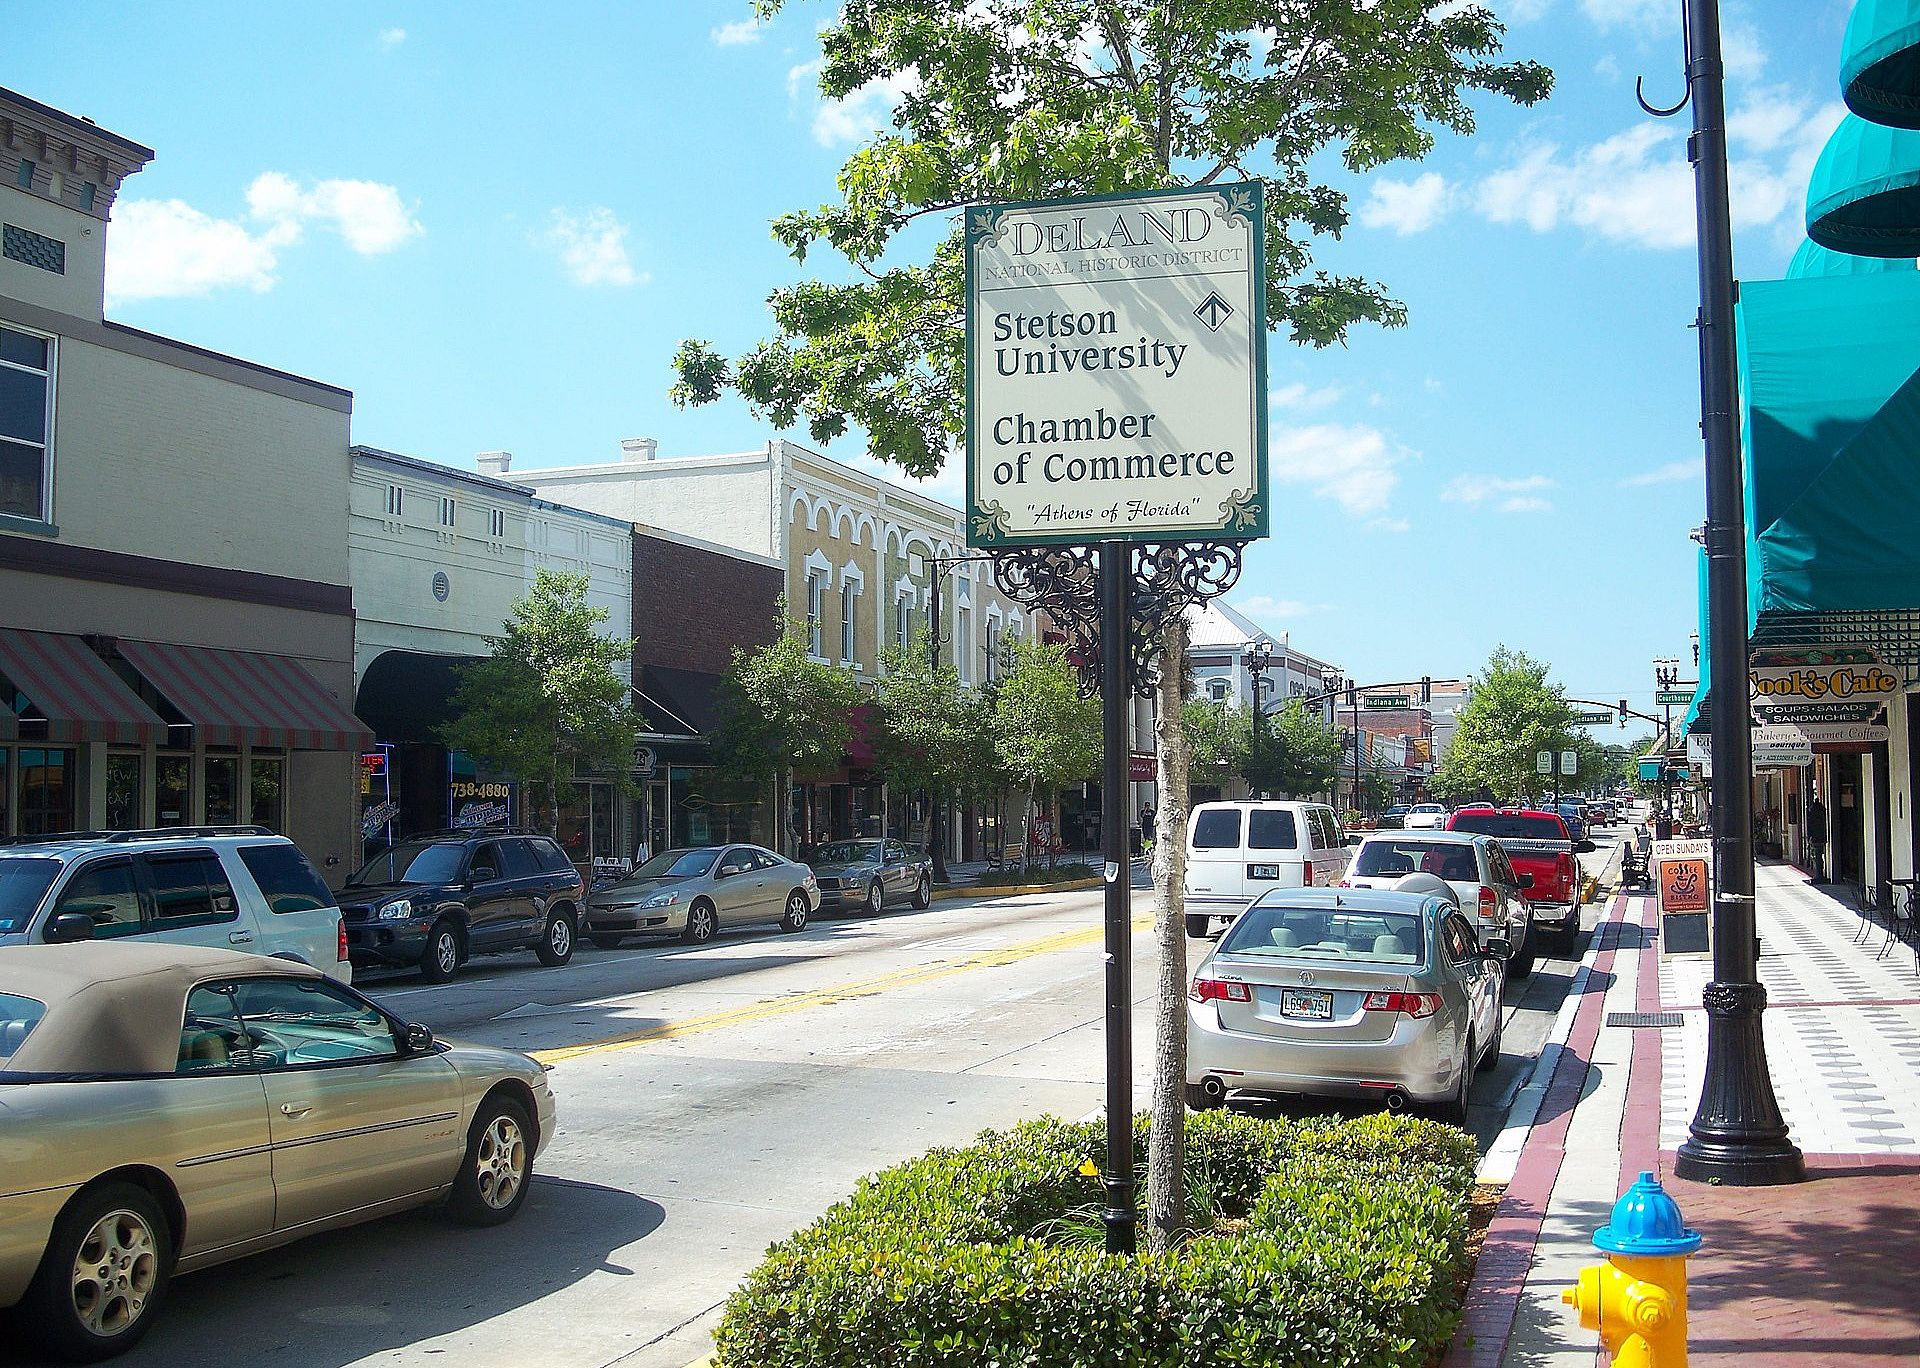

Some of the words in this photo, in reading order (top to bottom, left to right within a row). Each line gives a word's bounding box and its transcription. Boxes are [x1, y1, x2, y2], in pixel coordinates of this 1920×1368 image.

[1012, 207, 1212, 256] DELAND
[985, 262, 1074, 280] NATIONAL
[1079, 253, 1158, 273] HISTORIC
[1162, 247, 1243, 267] DISTRICT
[994, 308, 1118, 342] Stetson
[994, 336, 1188, 379] University
[993, 408, 1155, 445] Chamber
[993, 451, 1032, 485] of
[1043, 449, 1235, 483] Commerce
[1027, 503, 1093, 525] "Athens
[1101, 502, 1119, 523] of
[1125, 497, 1200, 521] Florida"
[1830, 668, 1897, 698] Cafe
[1765, 706, 1810, 714] SOUPS
[1816, 704, 1867, 713] SALADS
[1773, 713, 1860, 723] SANDWICHES
[1753, 729, 1791, 741] Bakery
[1799, 728, 1843, 741] Gourmet
[1848, 726, 1885, 740] Coffees
[1656, 843, 1675, 855] OPEN
[1676, 842, 1709, 854] SUNDAYS
[1667, 862, 1698, 875] COFFEE
